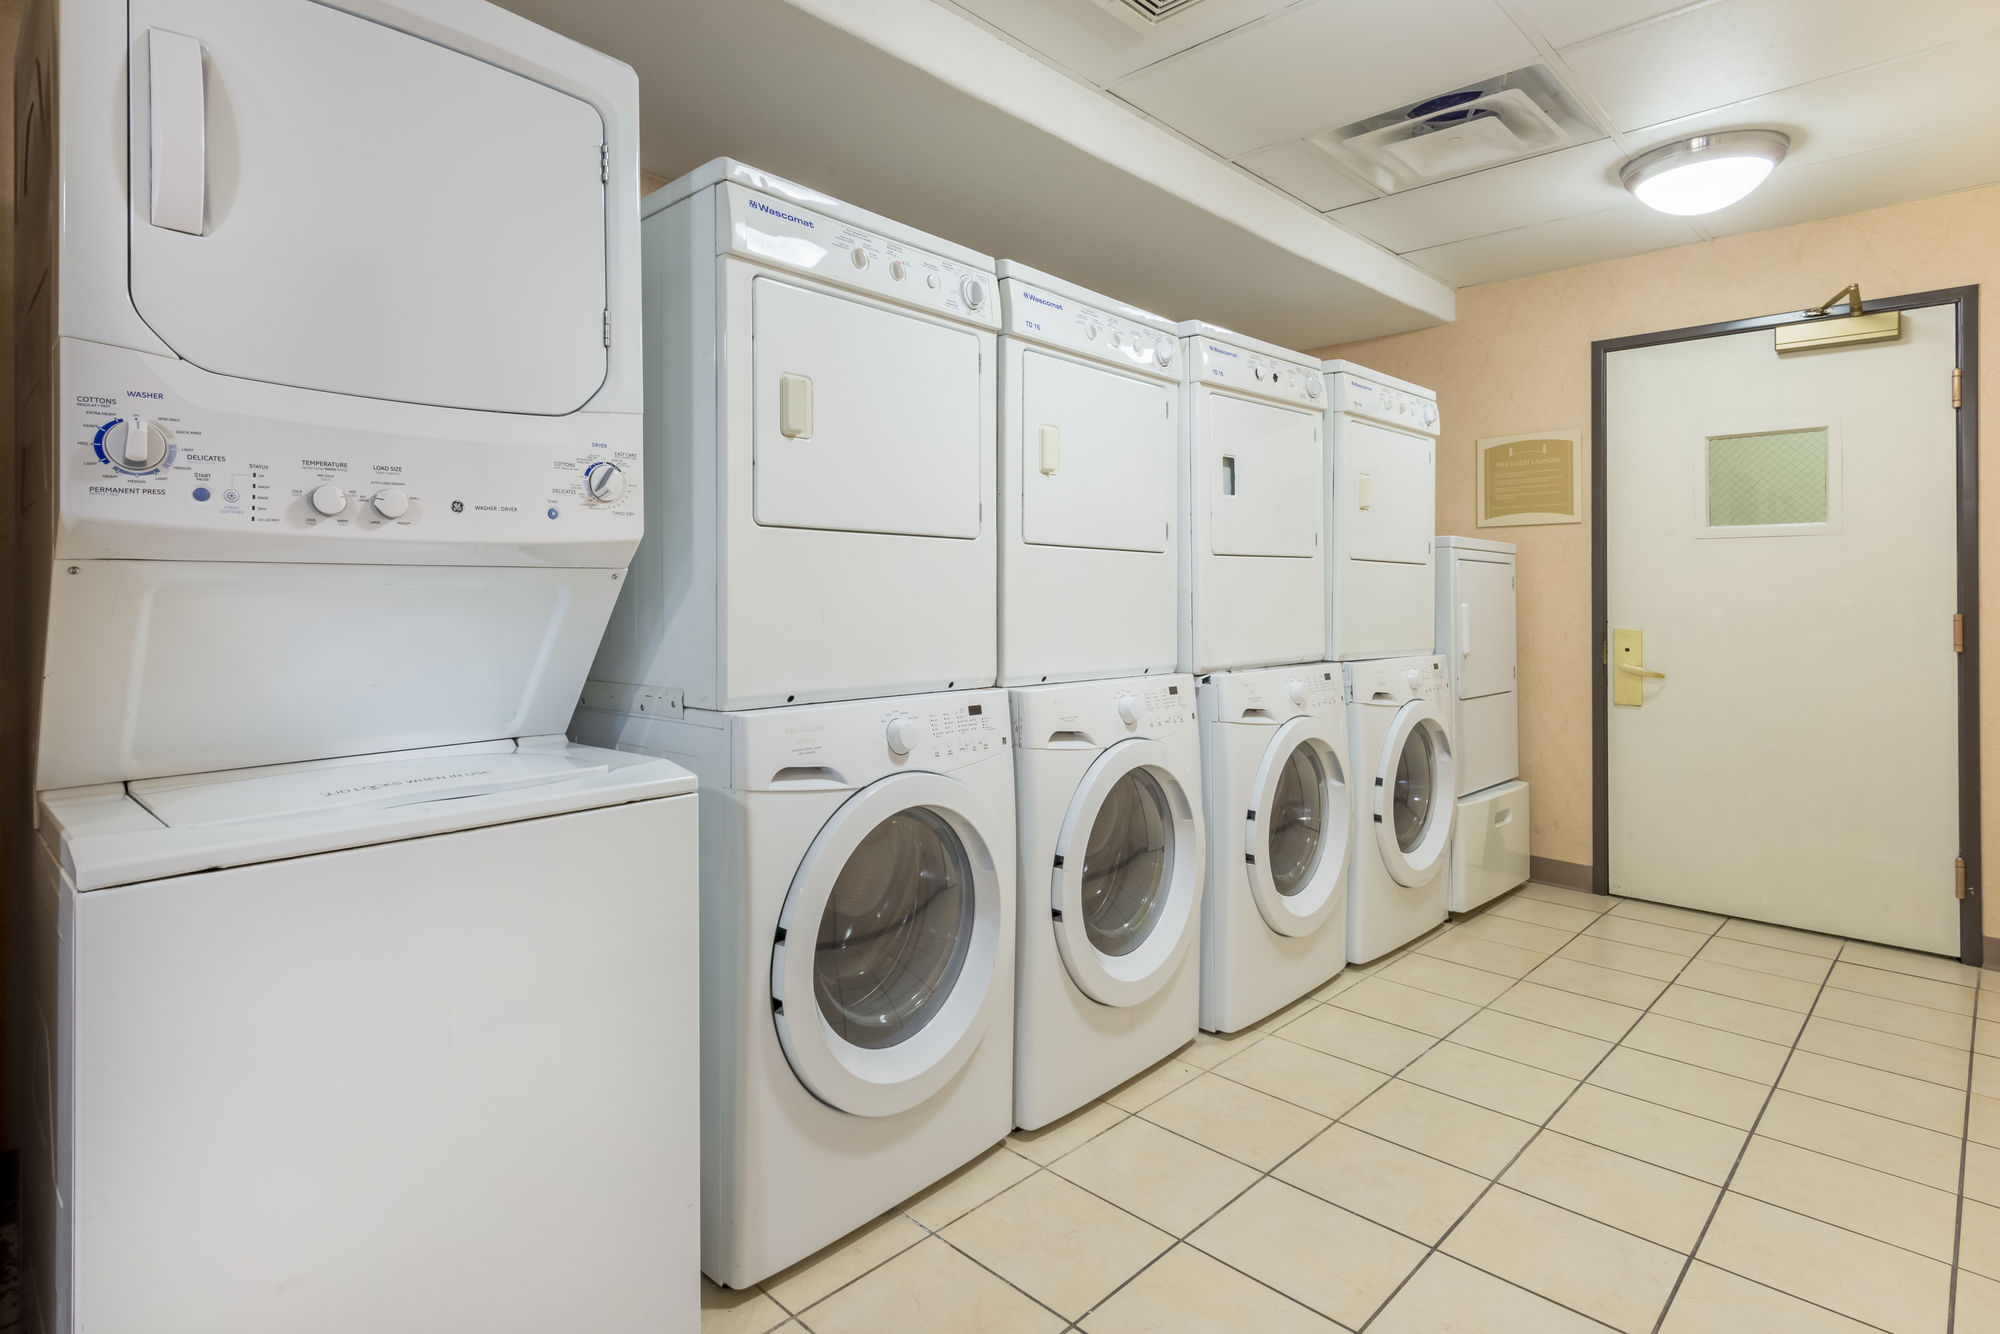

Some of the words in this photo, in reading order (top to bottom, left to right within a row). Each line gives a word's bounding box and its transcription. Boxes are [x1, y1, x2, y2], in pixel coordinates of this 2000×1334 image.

[757, 201, 815, 229] Wascomat
[1028, 293, 1064, 311] Wascomat
[1025, 320, 1033, 328] TD
[76, 395, 117, 405] COTTONS
[126, 390, 164, 400] WASHER
[186, 453, 226, 463] DELICATES
[301, 459, 348, 469] TEMPERATURE
[89, 486, 140, 495] PERMANENT
[142, 487, 166, 496] PRESS
[355, 781, 402, 791] LOCKS
[406, 775, 447, 784] WHEN
